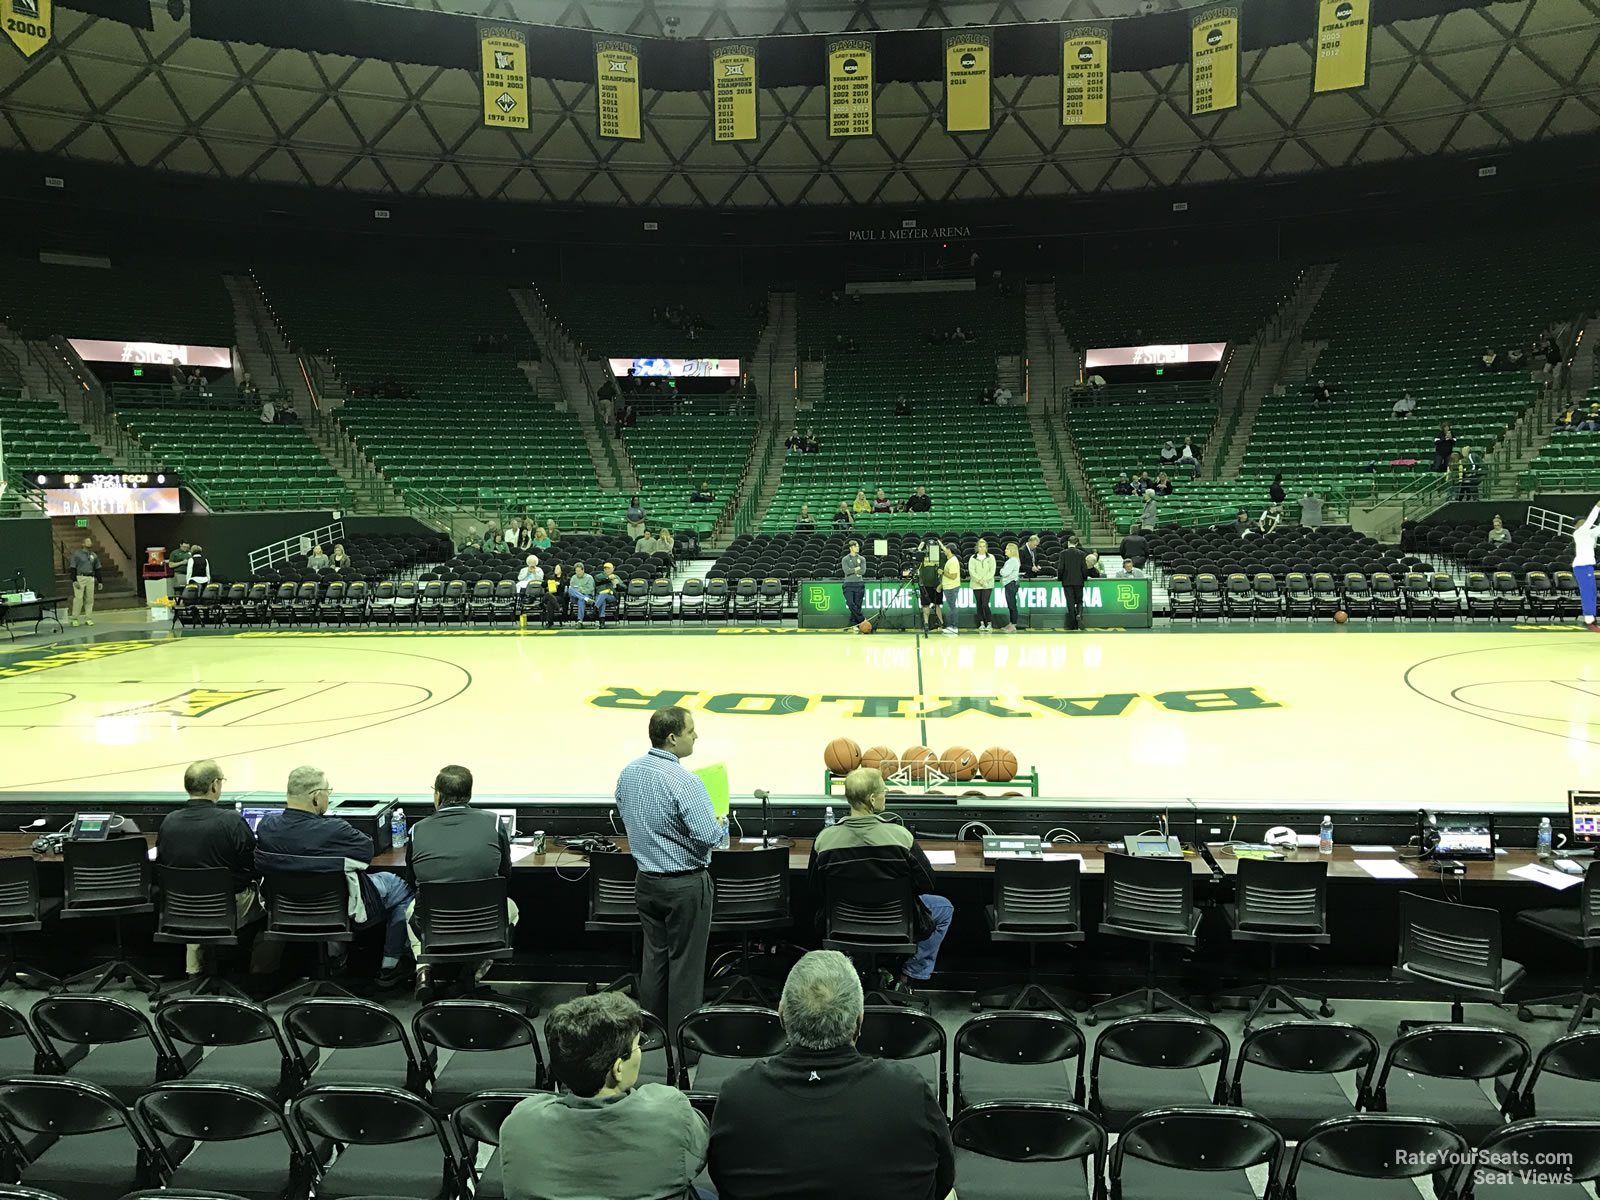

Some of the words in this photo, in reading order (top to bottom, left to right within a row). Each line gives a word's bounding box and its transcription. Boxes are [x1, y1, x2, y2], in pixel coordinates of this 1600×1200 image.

[1192, 7, 1238, 29] BAYLOR
[8, 18, 46, 38] 2000
[1064, 27, 1108, 41] BAYLOR
[1322, 22, 1344, 32] FINAL
[480, 27, 526, 44] BAYLOR
[947, 34, 990, 49] BAYLOR
[596, 41, 638, 56] BAYLOR
[713, 45, 755, 59] BAYLOR
[829, 40, 872, 54] BAYLOR
[1196, 48, 1214, 57] ELITE
[1215, 44, 1233, 52] EIGHT
[1321, 41, 1340, 49] 2010
[1196, 65, 1212, 73] 2010
[1196, 72, 1212, 80] 2011
[1196, 88, 1212, 96] 2014
[849, 230, 876, 240] PAUL
[880, 230, 886, 240] J.
[890, 228, 928, 239] MEYER
[931, 227, 971, 238] ARENA
[38, 474, 46, 484] 0
[64, 474, 79, 483] BU
[122, 474, 148, 483] FGCU
[157, 475, 165, 484] 0
[64, 500, 146, 513] BASKETBALL
[810, 586, 830, 611] BU
[845, 588, 912, 608] ELCOME
[1117, 584, 1140, 609] BU
[590, 686, 1291, 718] BAYLOR
